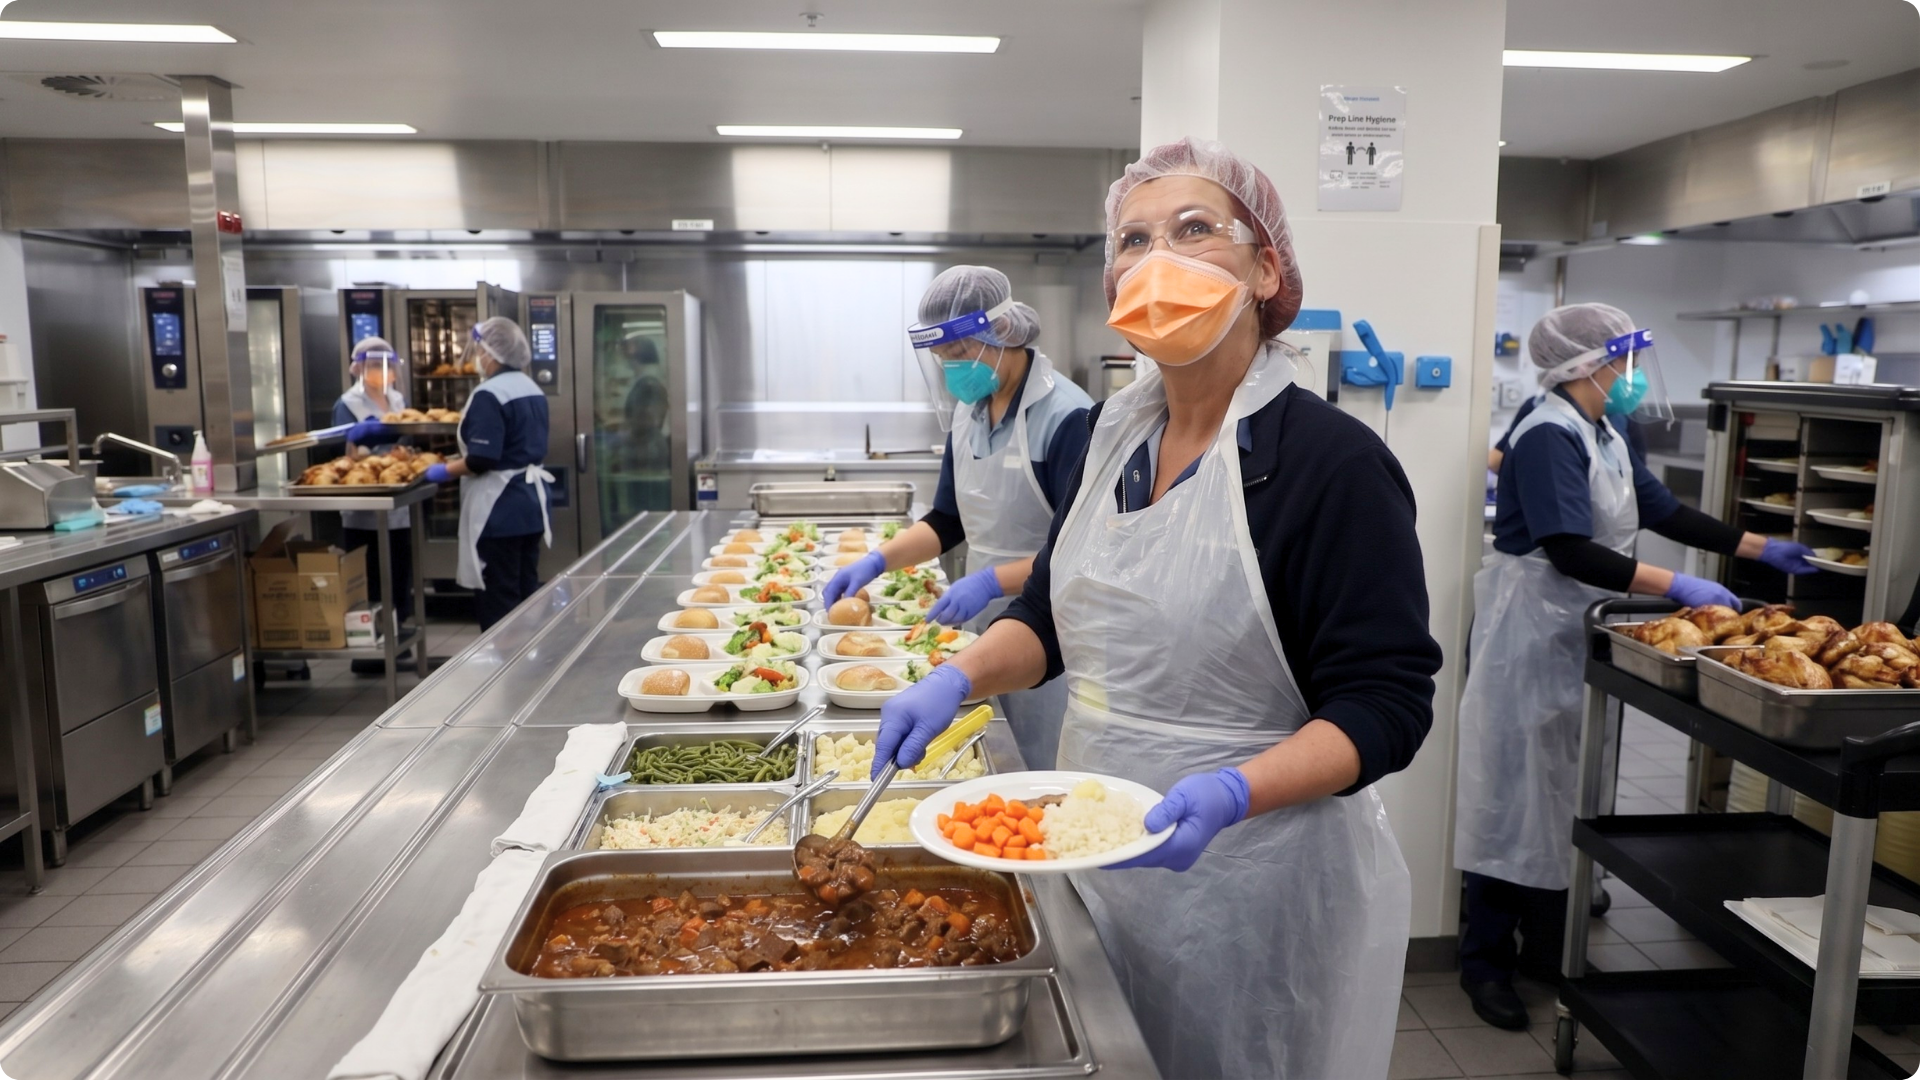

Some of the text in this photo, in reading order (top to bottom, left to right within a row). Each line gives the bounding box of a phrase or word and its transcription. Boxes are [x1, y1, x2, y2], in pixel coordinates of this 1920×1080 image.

[1328, 115, 1396, 125] Prep Line Hygiene
